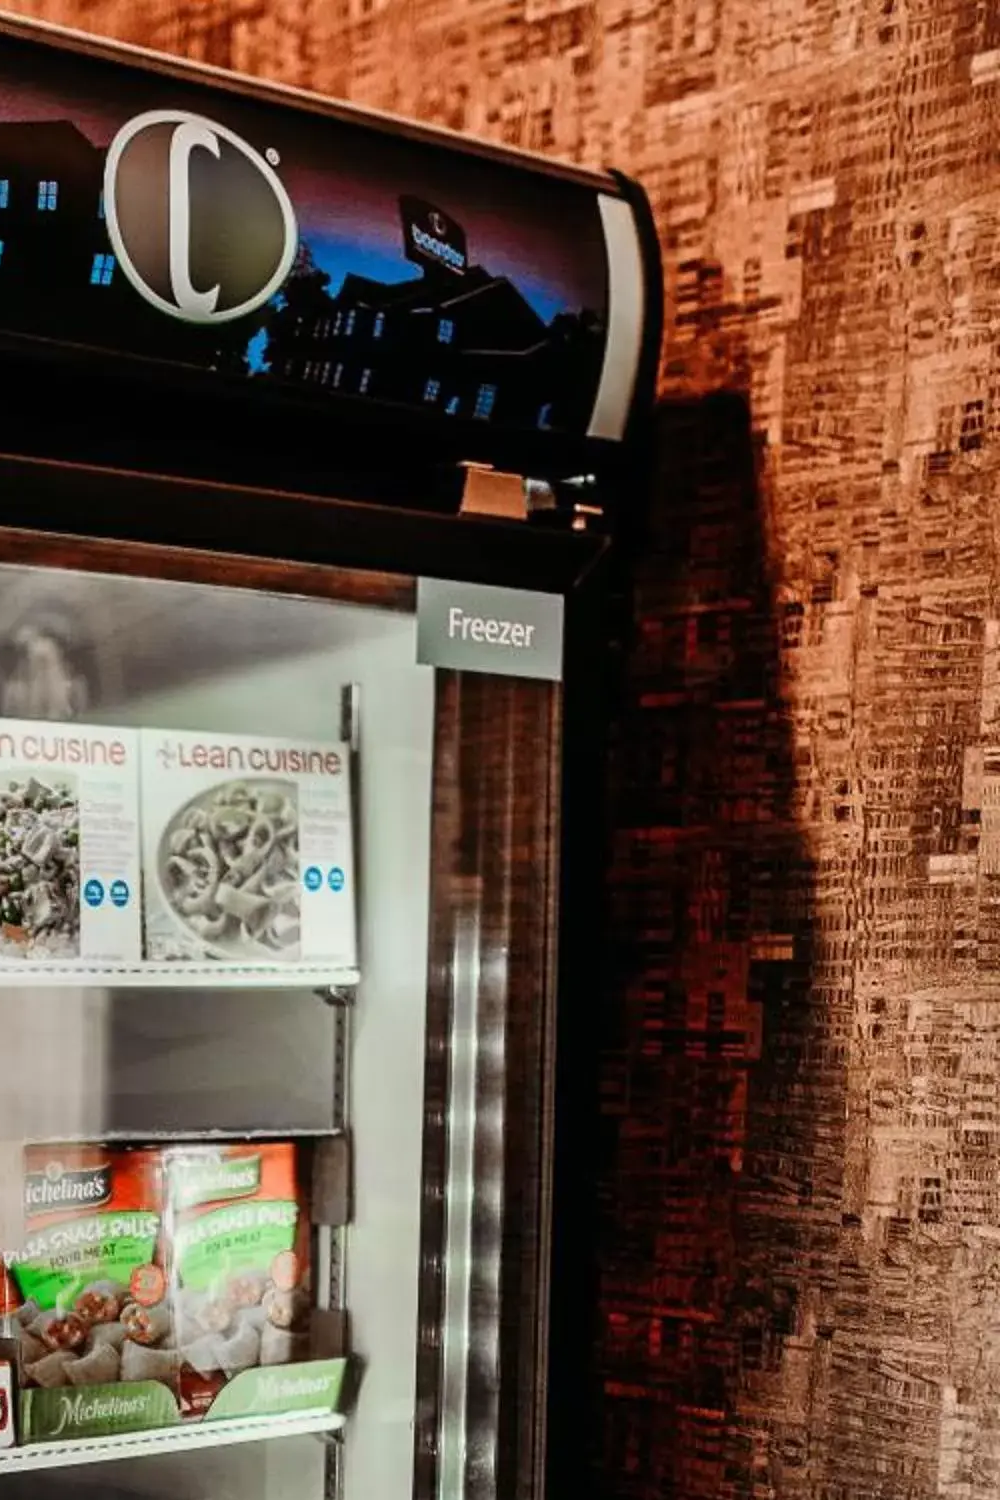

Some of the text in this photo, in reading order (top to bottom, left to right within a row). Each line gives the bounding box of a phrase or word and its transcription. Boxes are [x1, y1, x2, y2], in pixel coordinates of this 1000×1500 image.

[448, 607, 535, 646] Freezer
[177, 742, 245, 770] Lean
[25, 1174, 106, 1204] ichelina's
